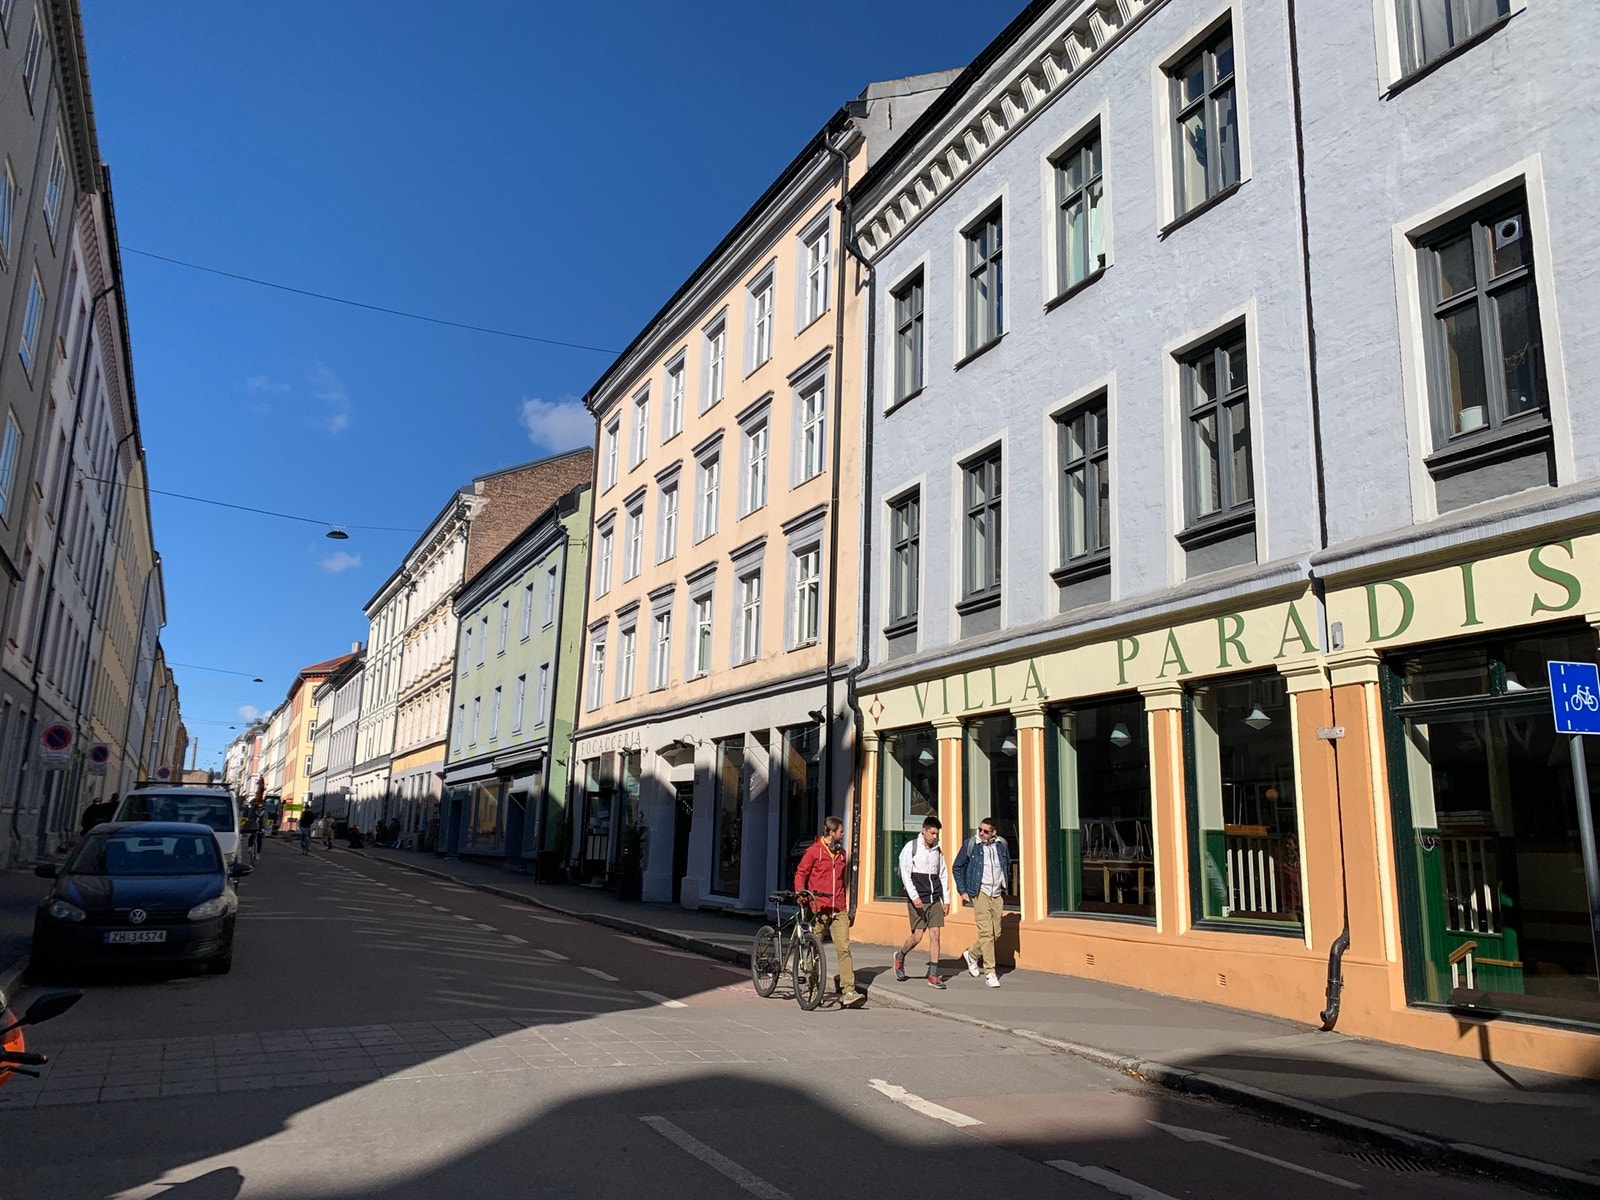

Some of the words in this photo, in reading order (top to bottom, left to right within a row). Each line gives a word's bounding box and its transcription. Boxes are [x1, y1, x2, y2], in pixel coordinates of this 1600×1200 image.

[912, 657, 1045, 719] VILLA
[1116, 539, 1582, 686] PARADIS
[580, 731, 641, 756] FOCACCERIA
[111, 931, 127, 942] ZH
